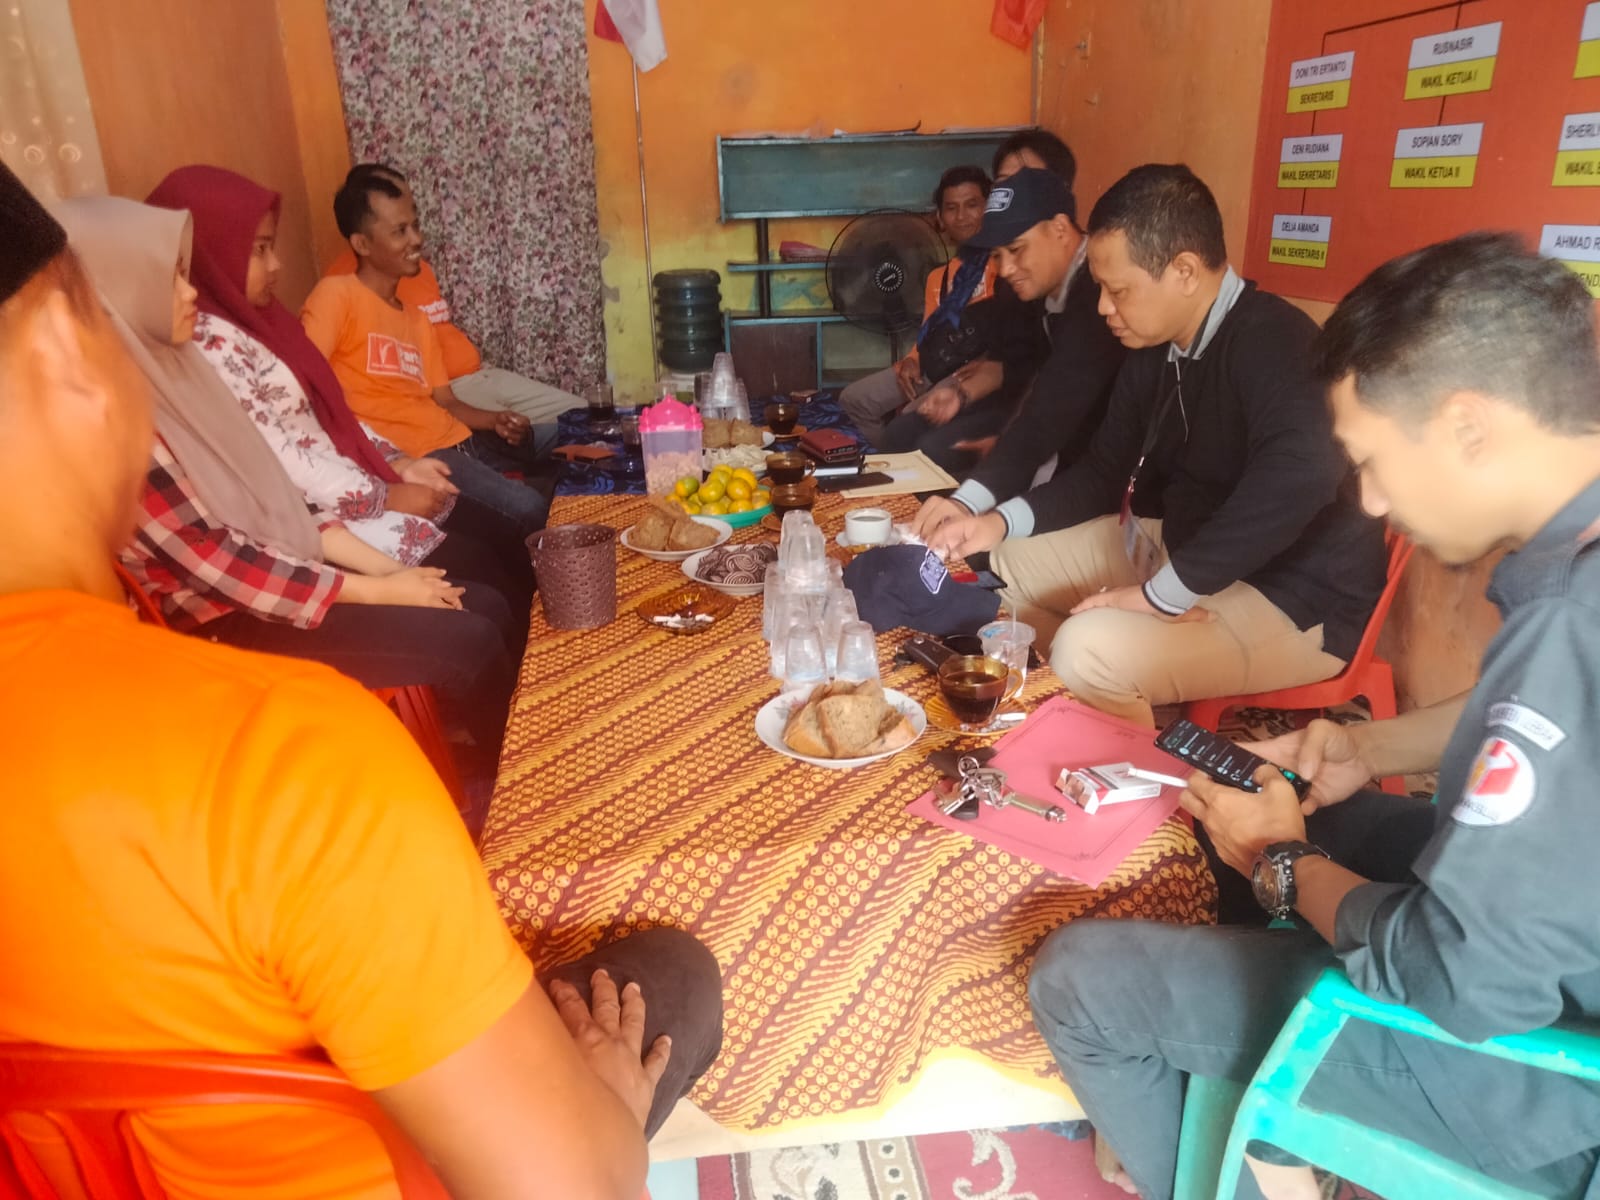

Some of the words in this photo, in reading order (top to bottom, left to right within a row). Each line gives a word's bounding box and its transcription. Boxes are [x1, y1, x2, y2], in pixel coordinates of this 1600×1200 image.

[1420, 74, 1444, 89] WAKIL
[1445, 70, 1473, 86] KETUA
[1300, 90, 1335, 105] SEKRETARIS
[1565, 123, 1600, 139] SHERL
[1411, 135, 1439, 149] SOPIAN
[1440, 133, 1464, 147] SORY
[1281, 170, 1297, 181] WAKIL
[1298, 169, 1331, 181] SEKRETARIS
[1404, 167, 1426, 179] WAKIL
[1427, 165, 1454, 179] KETUA
[1565, 161, 1595, 176] WAKIL
[1553, 234, 1592, 250] AHMAD
[1271, 246, 1287, 257] WAKIL
[1287, 247, 1320, 260] SEKRETARIS
